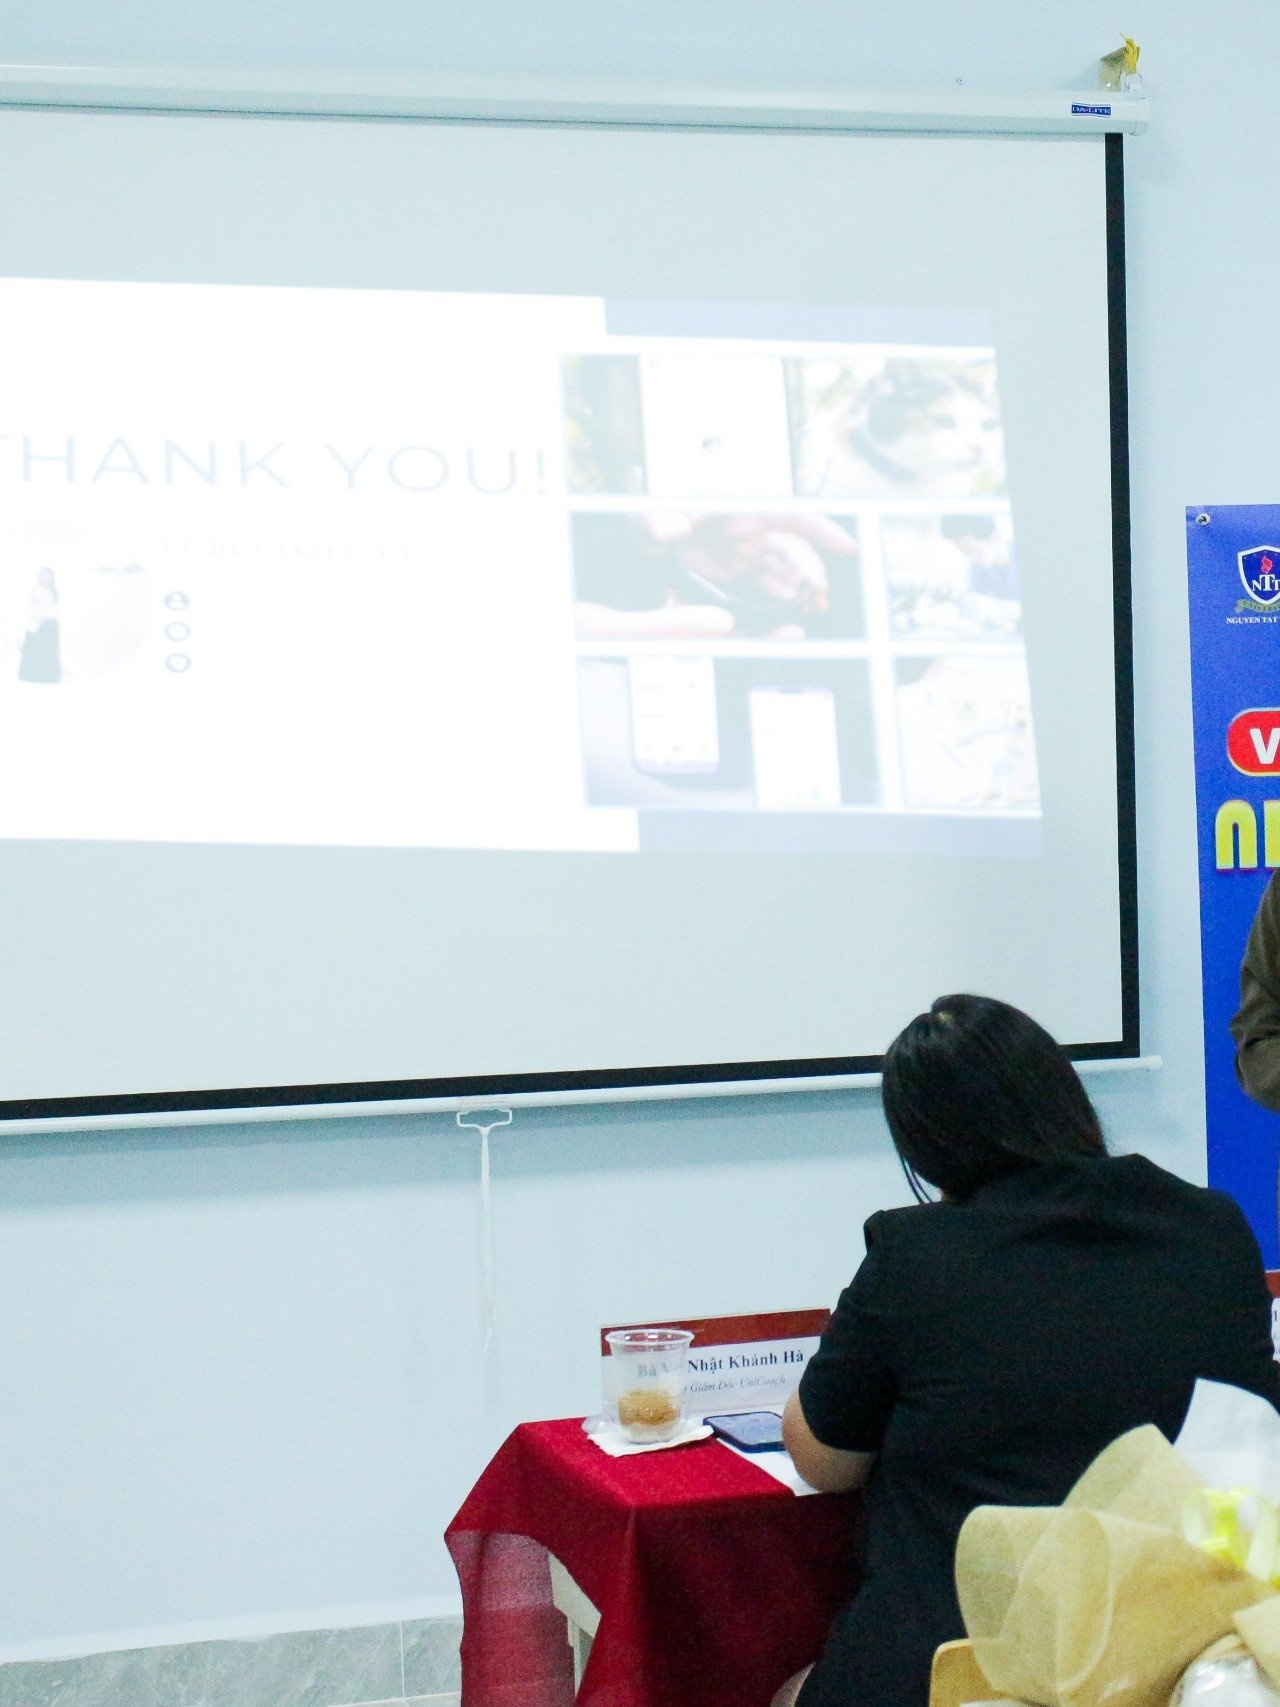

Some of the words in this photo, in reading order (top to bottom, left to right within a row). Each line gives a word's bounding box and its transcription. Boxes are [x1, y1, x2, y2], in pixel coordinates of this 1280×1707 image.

[0, 433, 290, 489] HANK
[323, 440, 549, 495] YOU!
[1226, 616, 1261, 624] NGUYEN
[688, 1359, 724, 1374] Nhật
[729, 1351, 778, 1369] Khánh
[783, 1349, 804, 1363] Hà
